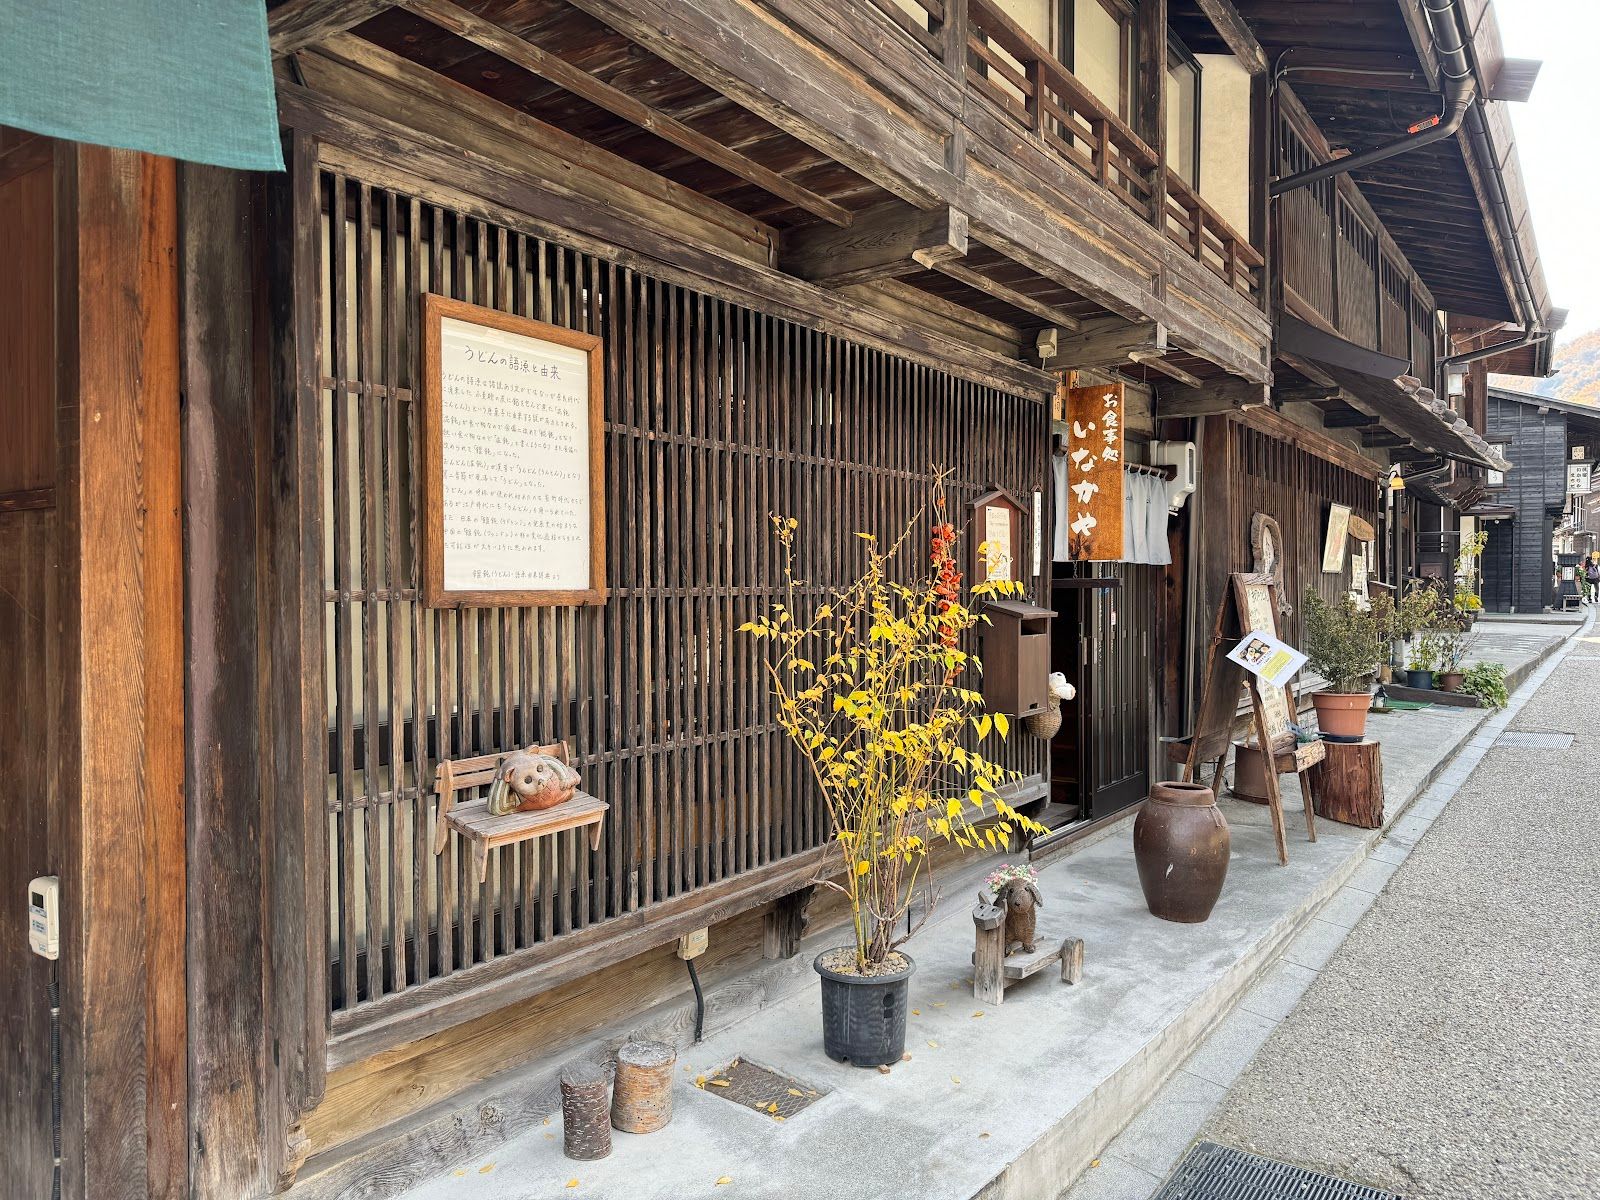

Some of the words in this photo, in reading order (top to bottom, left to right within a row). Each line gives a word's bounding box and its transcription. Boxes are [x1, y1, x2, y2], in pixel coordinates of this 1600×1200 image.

[464, 345, 561, 381] うどんの語源と由来
[1102, 393, 1119, 462] お食事処
[1071, 420, 1099, 536] いなかや
